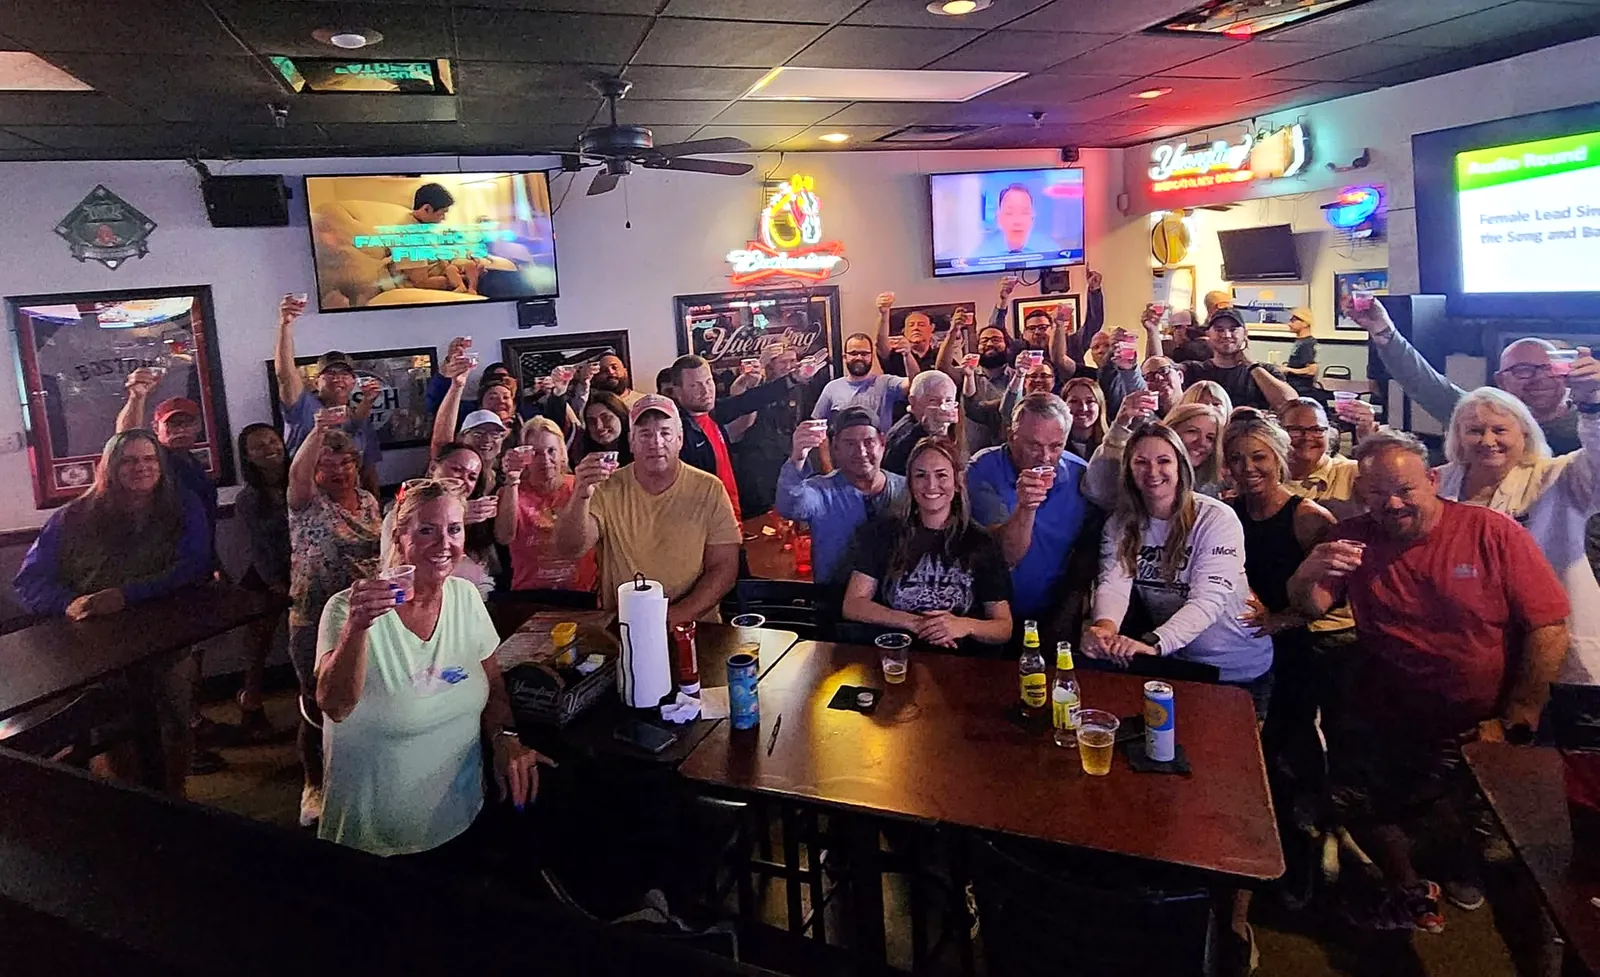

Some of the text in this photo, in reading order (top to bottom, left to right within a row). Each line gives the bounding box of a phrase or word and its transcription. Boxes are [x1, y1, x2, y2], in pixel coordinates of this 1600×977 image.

[1468, 145, 1588, 174] Audio Round
[1480, 210, 1530, 224] Female
[1535, 207, 1571, 220] Lead
[1481, 233, 1503, 244] the
[1507, 231, 1543, 244] Song
[1548, 227, 1576, 240] and
